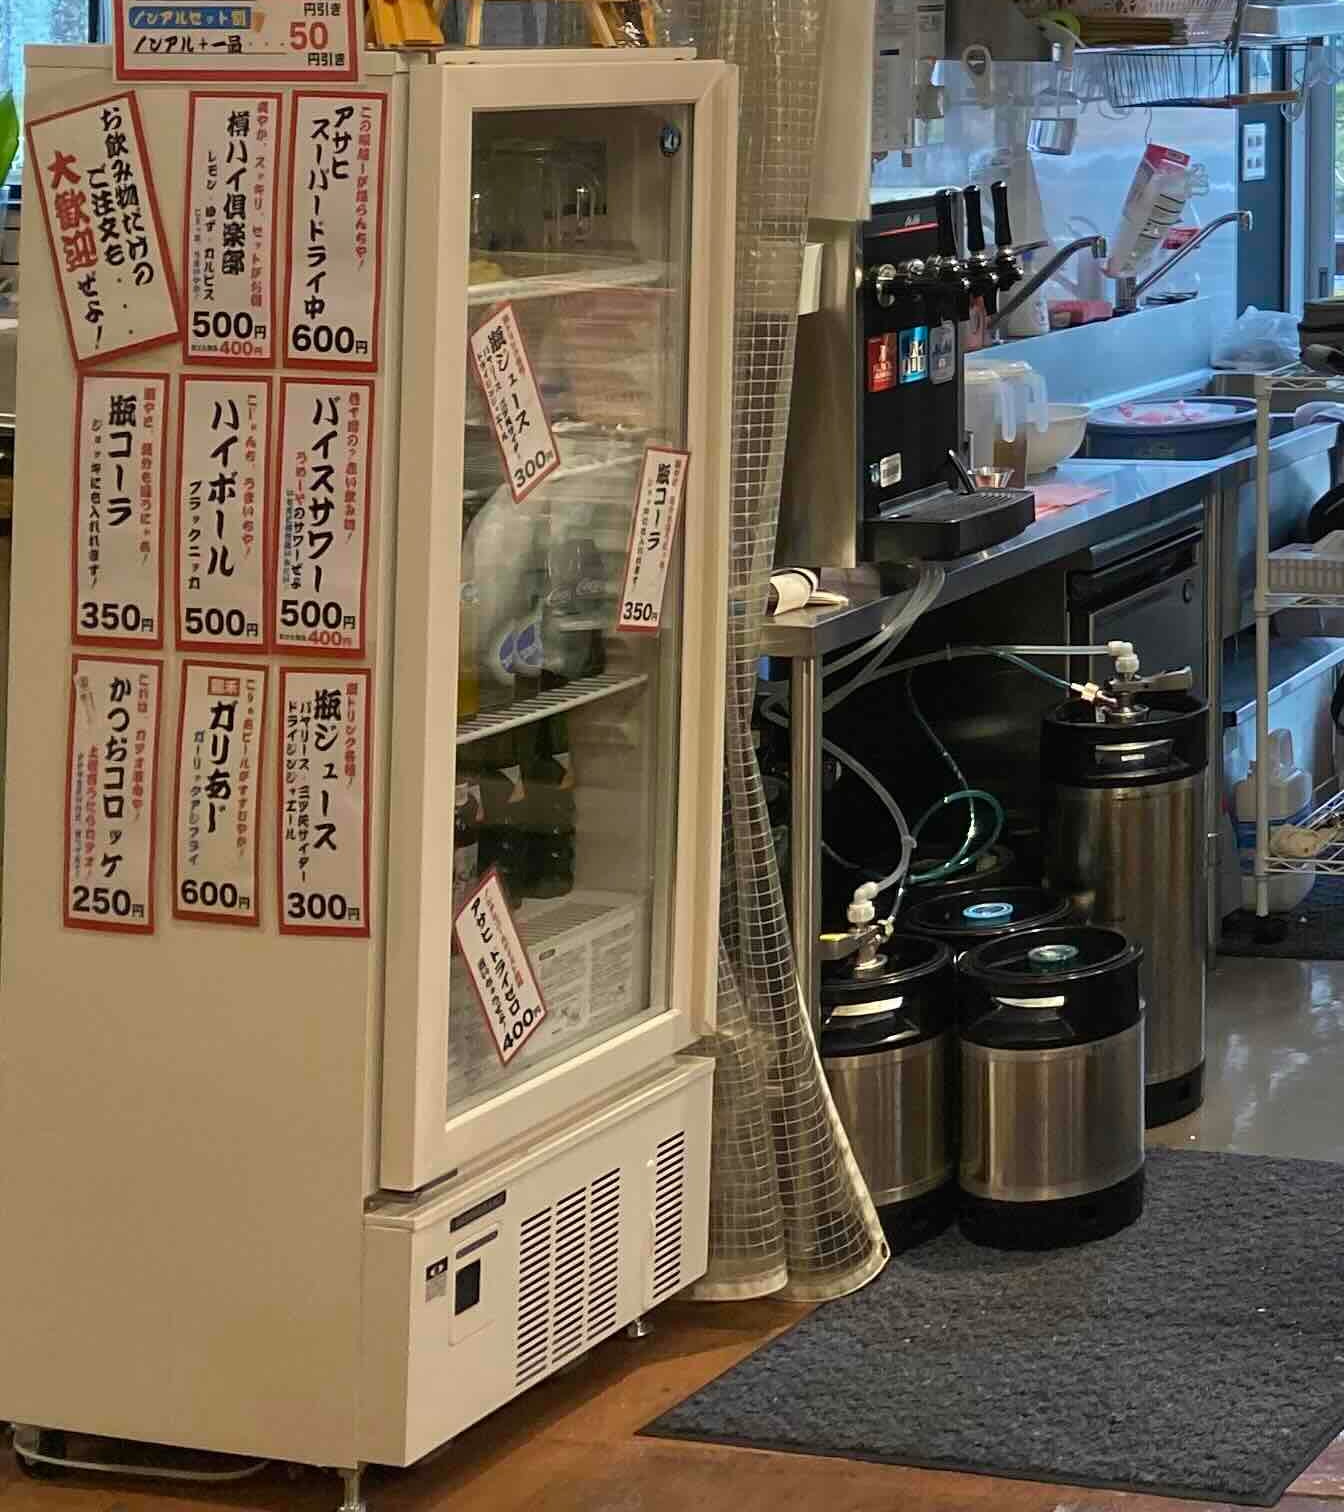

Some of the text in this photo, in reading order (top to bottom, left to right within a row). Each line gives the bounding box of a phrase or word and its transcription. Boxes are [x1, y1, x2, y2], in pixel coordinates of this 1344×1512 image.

[288, 21, 329, 50] 50
[303, 3, 342, 17] 円引き
[331, 105, 355, 181] アサヒ
[100, 105, 155, 286] お飲み物だけの
[221, 110, 251, 276] 樽ハイ倶楽部
[303, 119, 330, 320] スーパードライ中
[191, 310, 267, 340] 500円
[291, 324, 369, 354] 600円
[106, 394, 137, 527] 瓶コーラ
[206, 399, 240, 577] ハイボール
[307, 395, 341, 593] バイスサワー
[80, 601, 154, 633] 350円
[184, 606, 259, 637] 500円
[279, 598, 356, 630] 500円
[99, 676, 132, 878] かつおコロッケ
[203, 699, 239, 833] ガリあじ
[313, 688, 342, 852] 瓶ジュース
[72, 885, 145, 919] 250円
[180, 878, 251, 910] 600円
[287, 891, 361, 921] 300円
